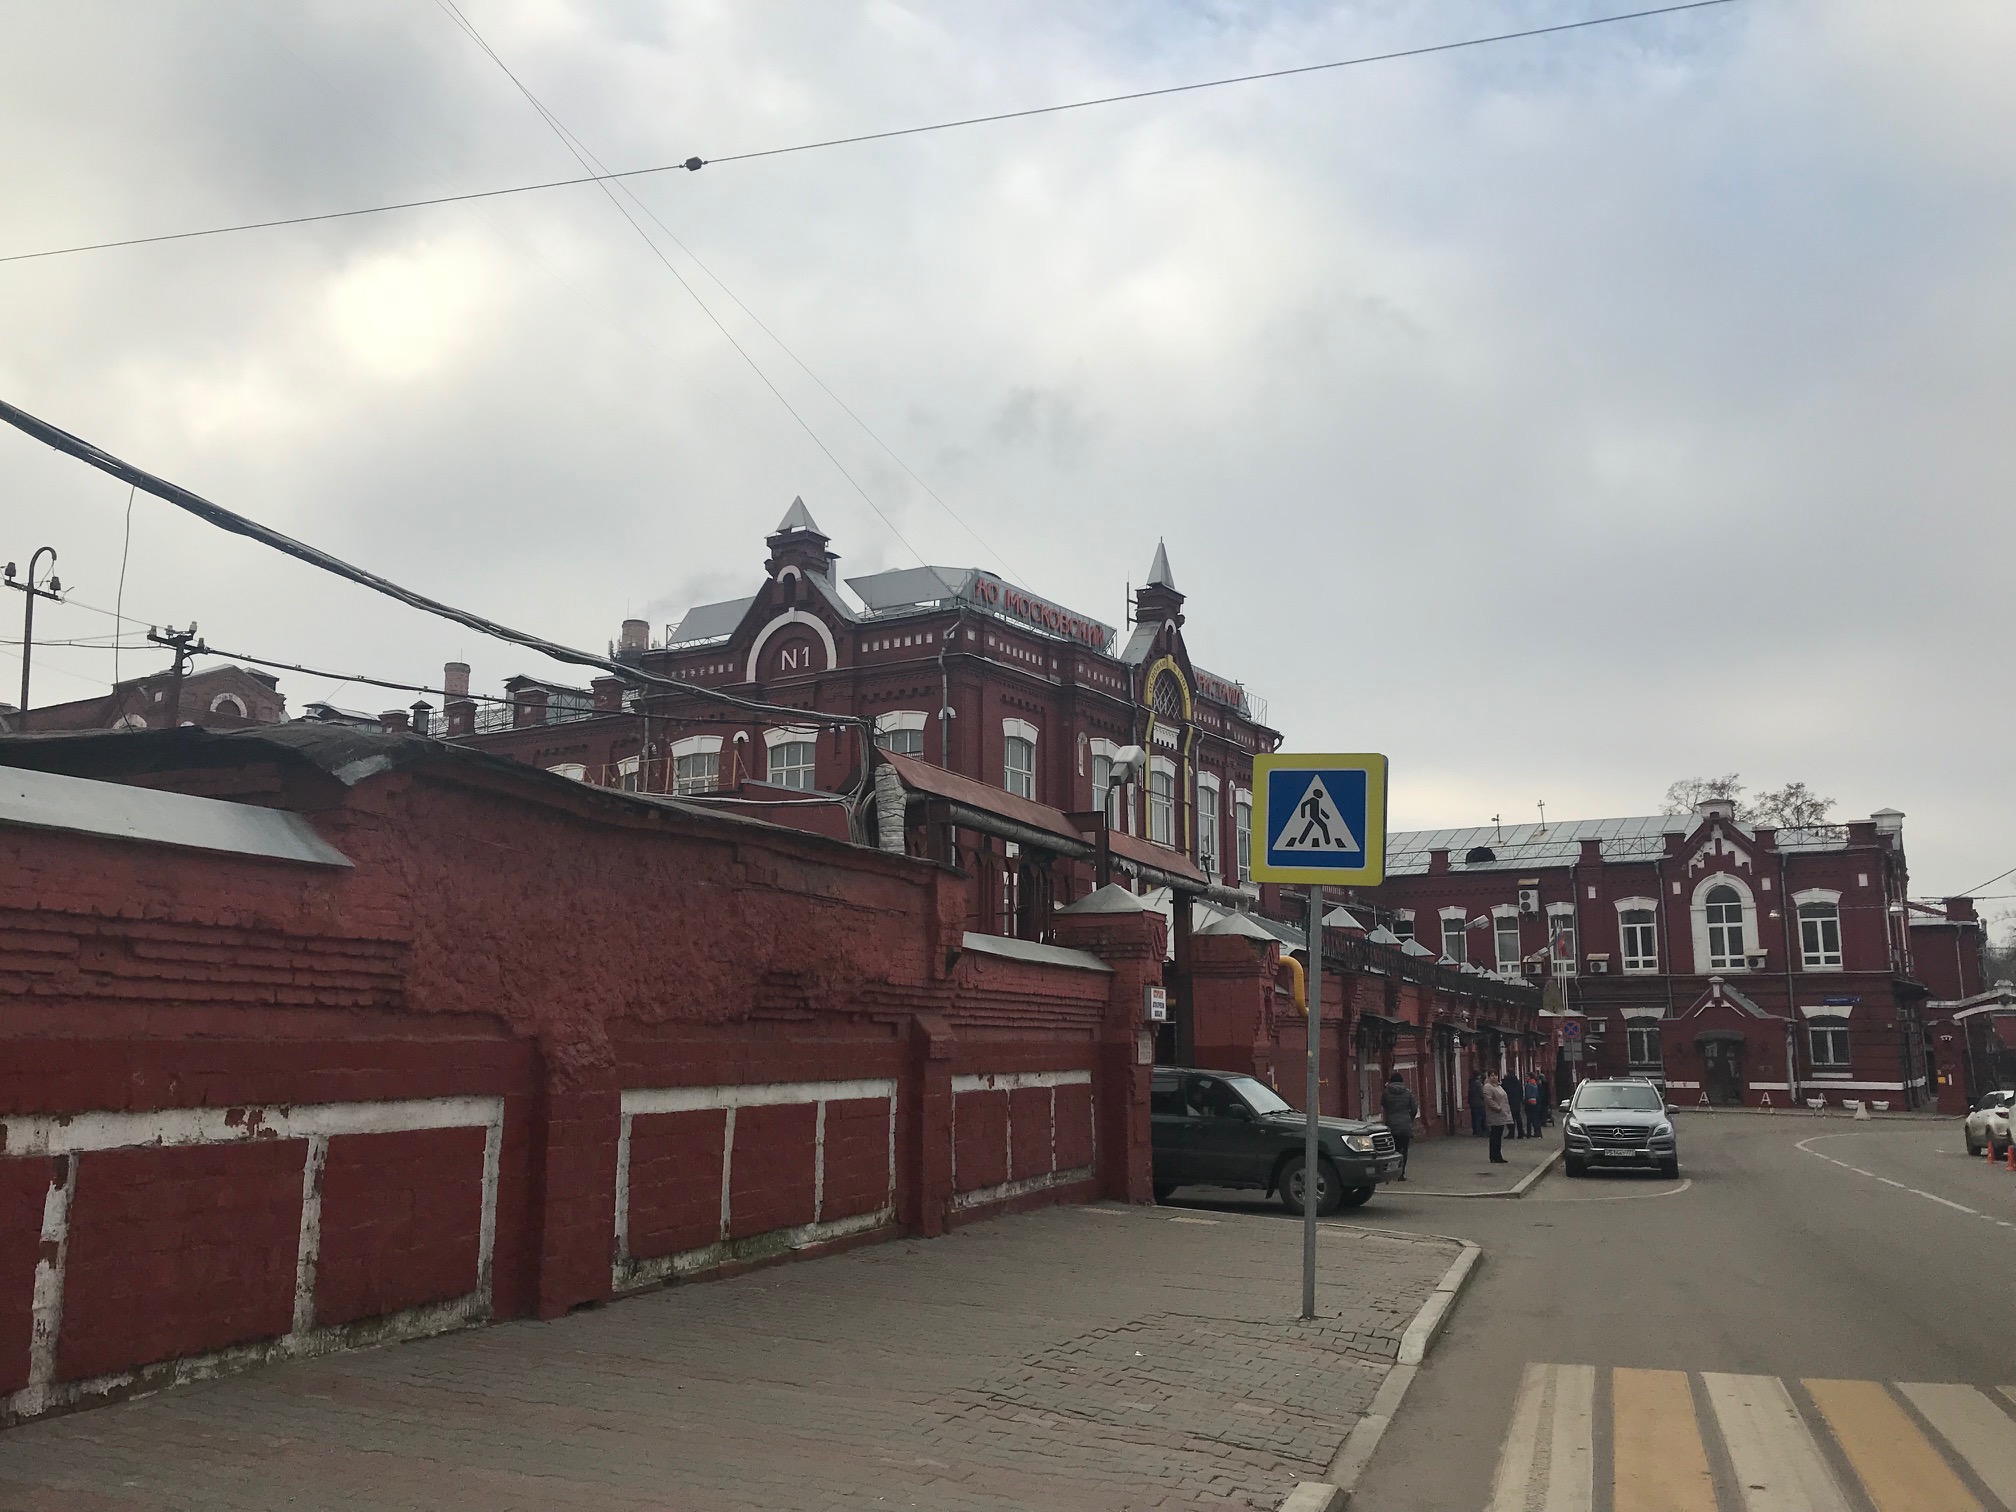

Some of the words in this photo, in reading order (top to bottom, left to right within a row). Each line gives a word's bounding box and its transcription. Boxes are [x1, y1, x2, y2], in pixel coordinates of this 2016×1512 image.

[975, 577, 999, 605] АО
[1005, 589, 1104, 645] МОСКОВСКИЙ
[782, 647, 809, 670] N1
[1196, 672, 1241, 705] РИСТАЛЛ
